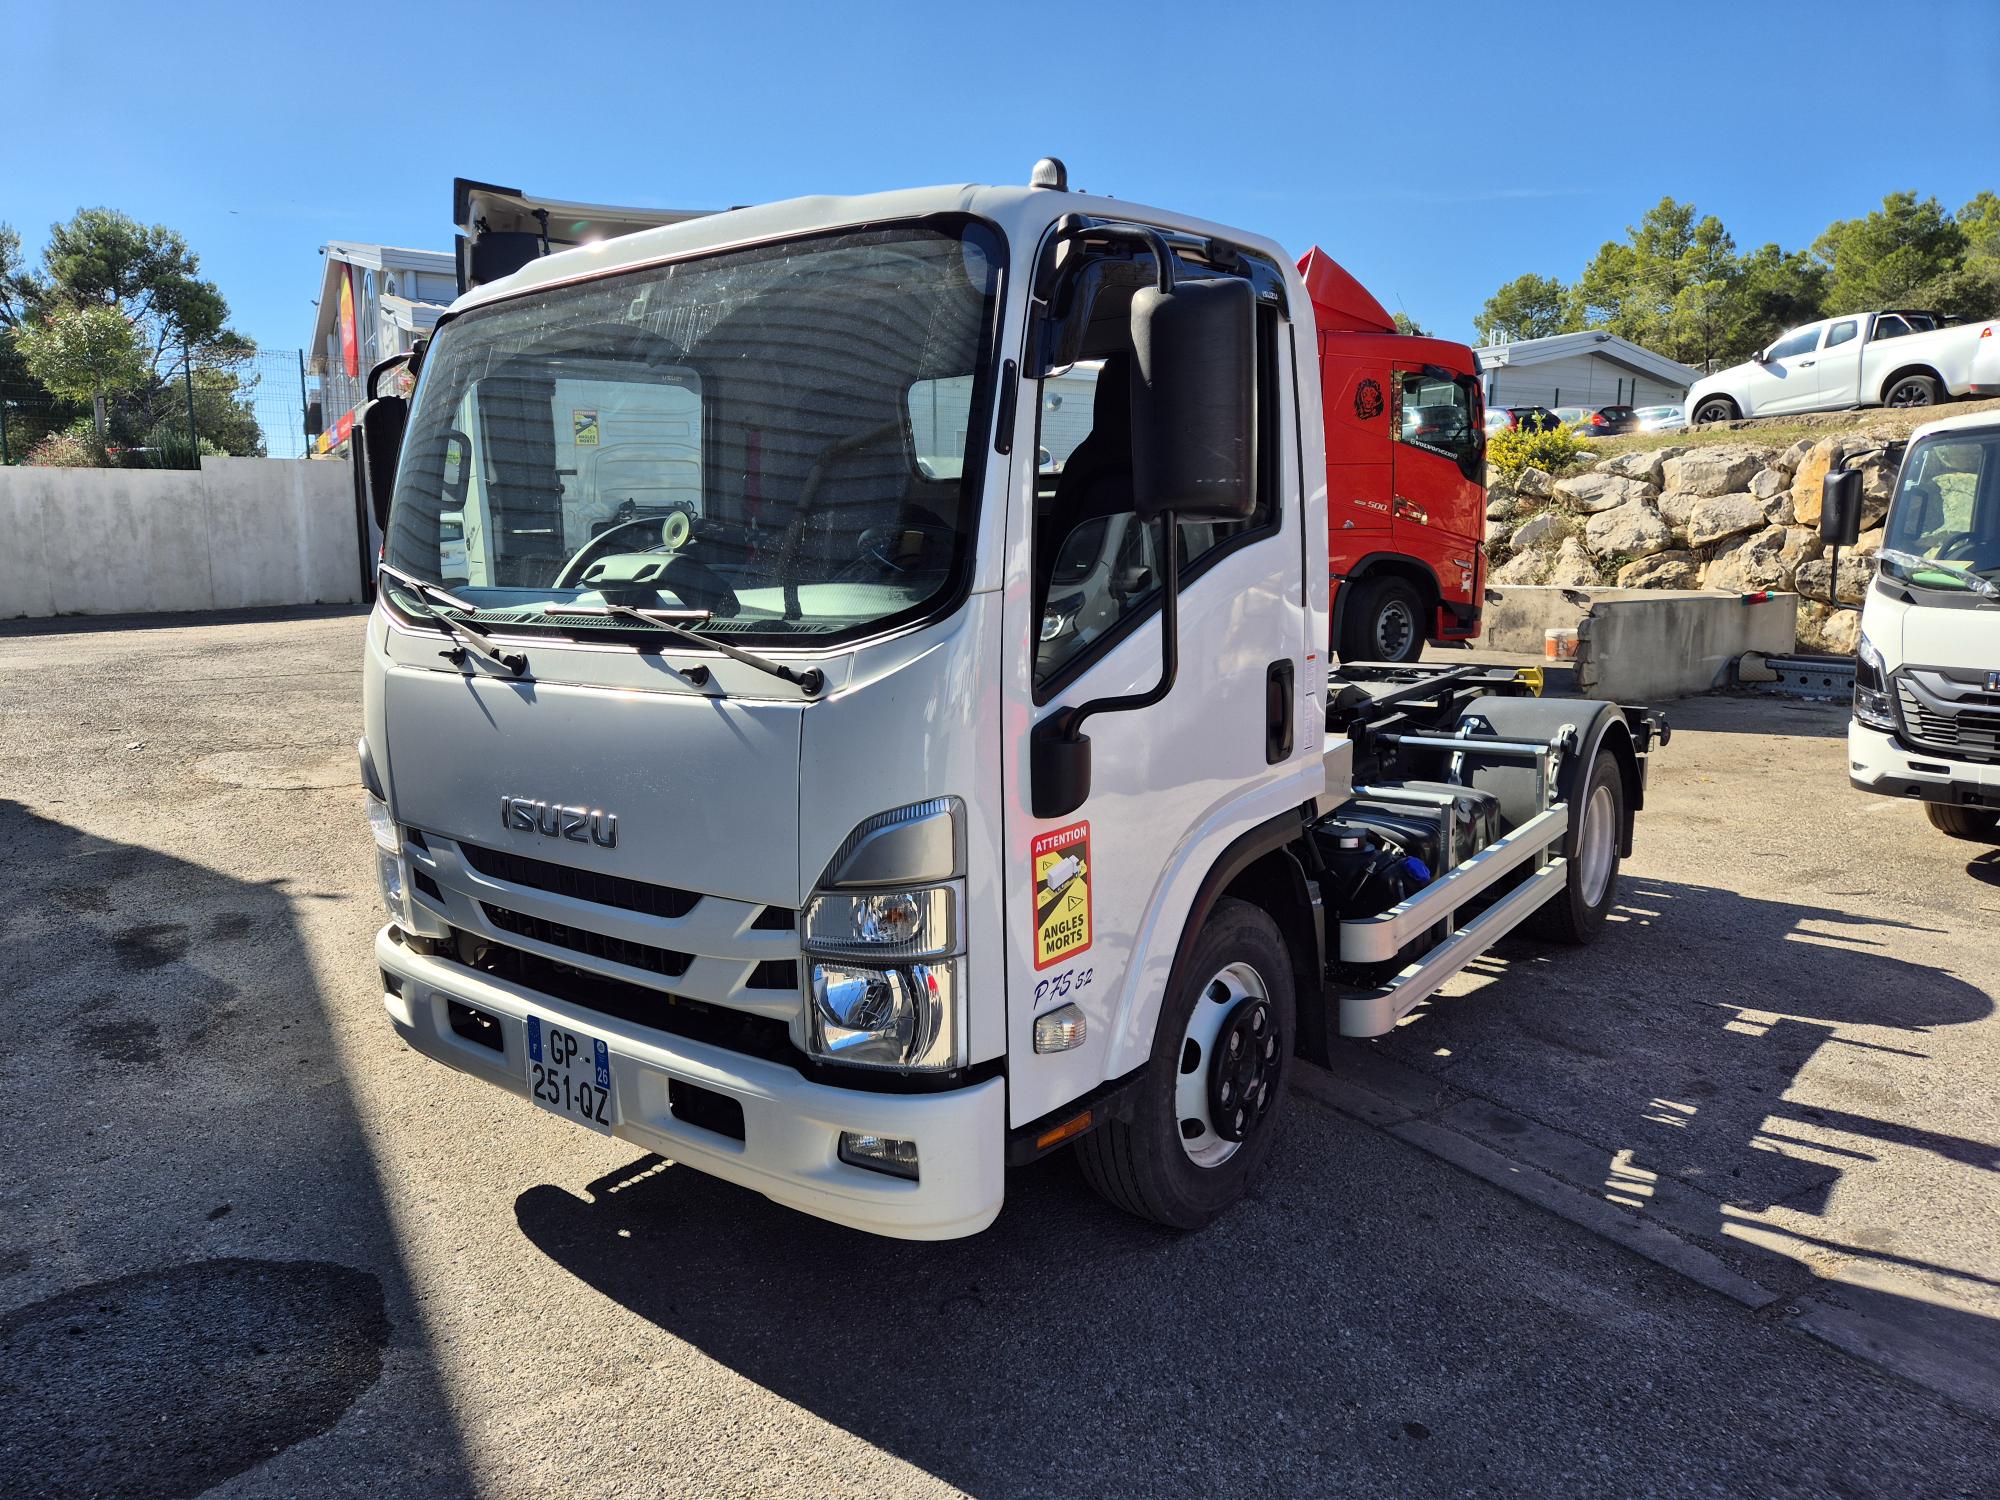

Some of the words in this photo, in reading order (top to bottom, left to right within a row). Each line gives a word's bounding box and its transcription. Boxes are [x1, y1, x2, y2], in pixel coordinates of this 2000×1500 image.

[1367, 500, 1388, 511] 500
[501, 795, 618, 849] ISUZU
[1035, 825, 1087, 853] ATTENTION
[1043, 914, 1084, 942] ANGLES
[1046, 928, 1083, 955] MORTS
[1033, 969, 1073, 1010] P75
[533, 1043, 538, 1054] F
[597, 1067, 608, 1085] 26
[533, 1063, 610, 1126] 251-QZ
